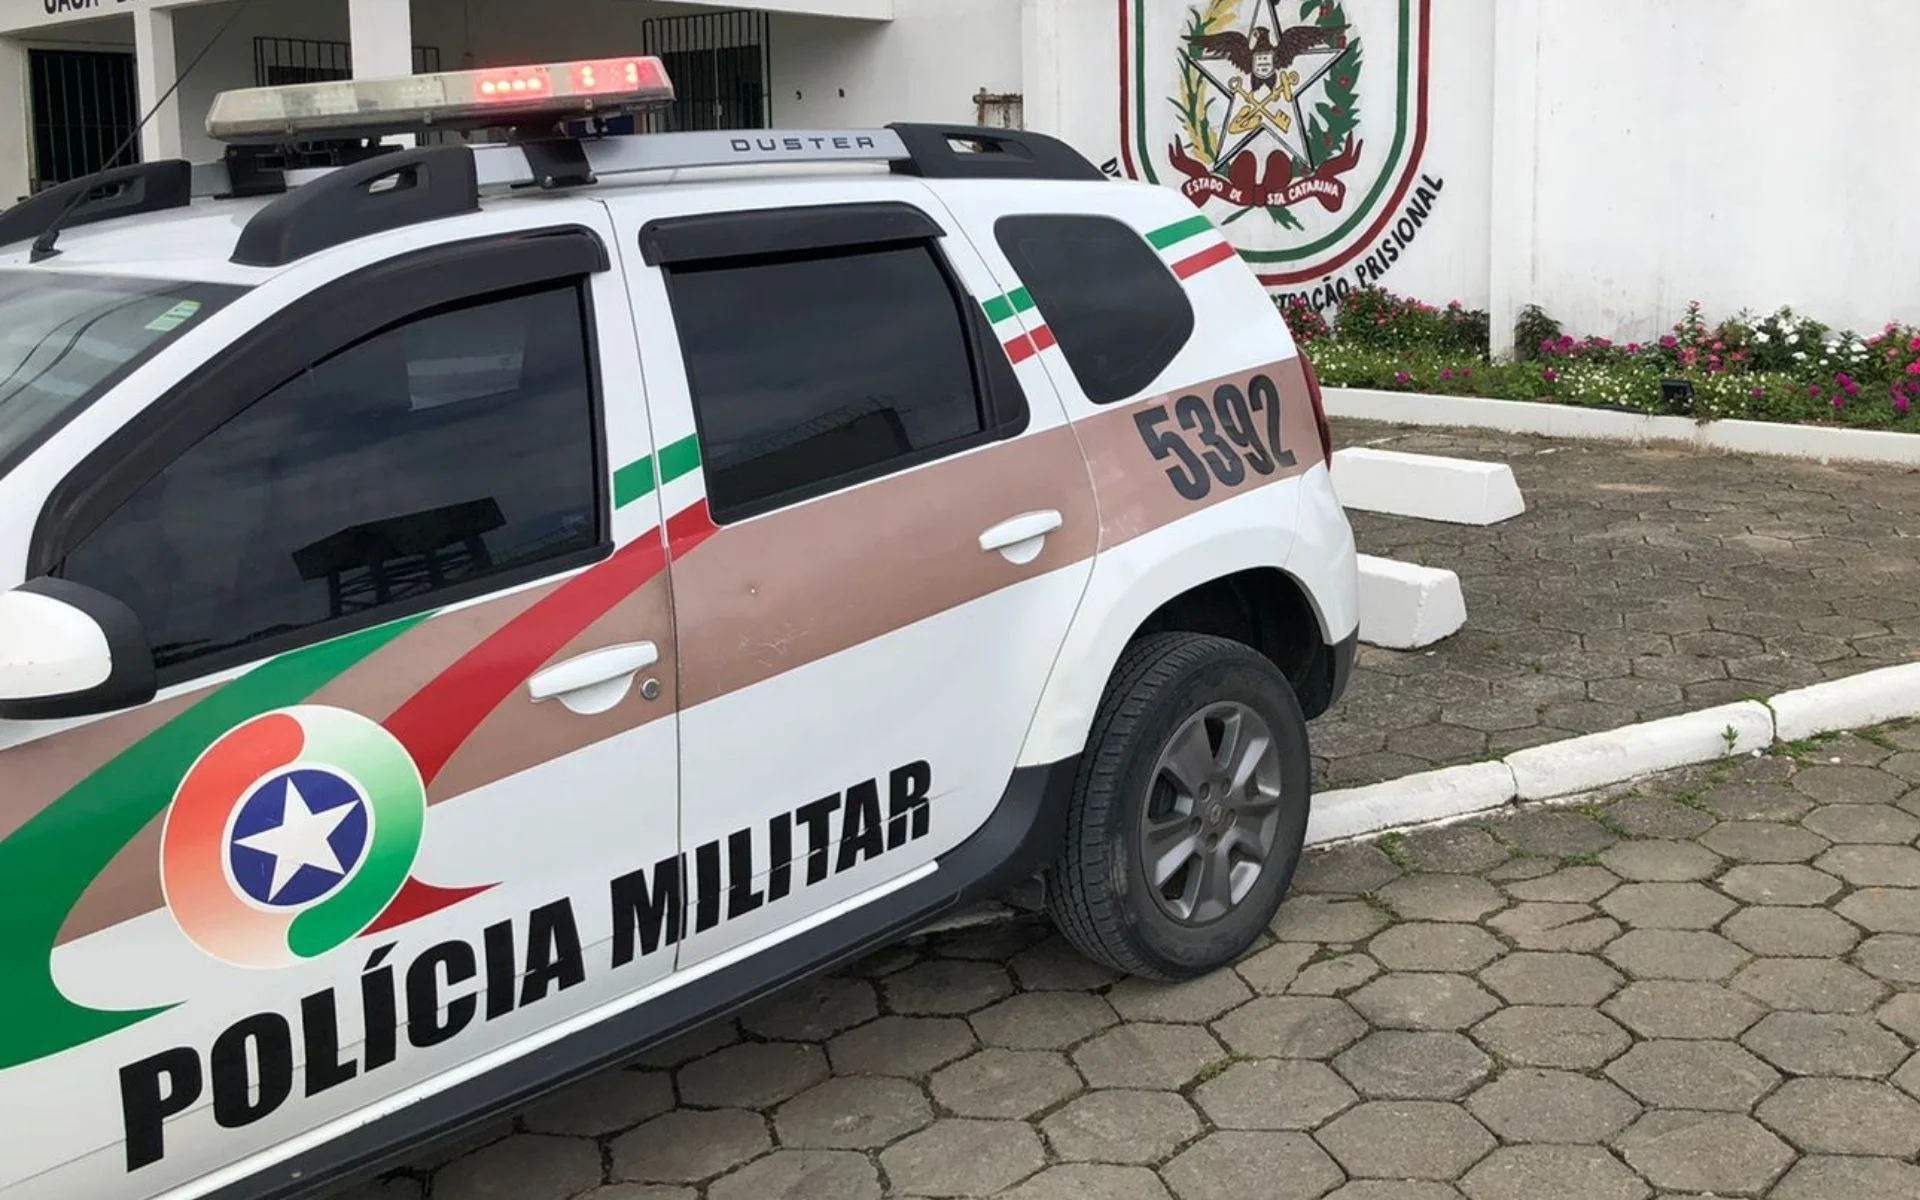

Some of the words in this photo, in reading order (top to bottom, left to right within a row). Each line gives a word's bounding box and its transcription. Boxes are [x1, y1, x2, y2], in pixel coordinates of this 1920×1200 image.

[730, 136, 875, 152] DUSTER
[1186, 177, 1223, 196] ESTADO
[1229, 188, 1243, 202] DE
[1267, 193, 1286, 205] STA
[1288, 180, 1339, 200] CATARINA
[1355, 174, 1444, 289] PRISIONAL
[1132, 374, 1298, 501] 5392
[119, 896, 586, 1173] POLÍCIA
[610, 759, 932, 970] MILITAR
